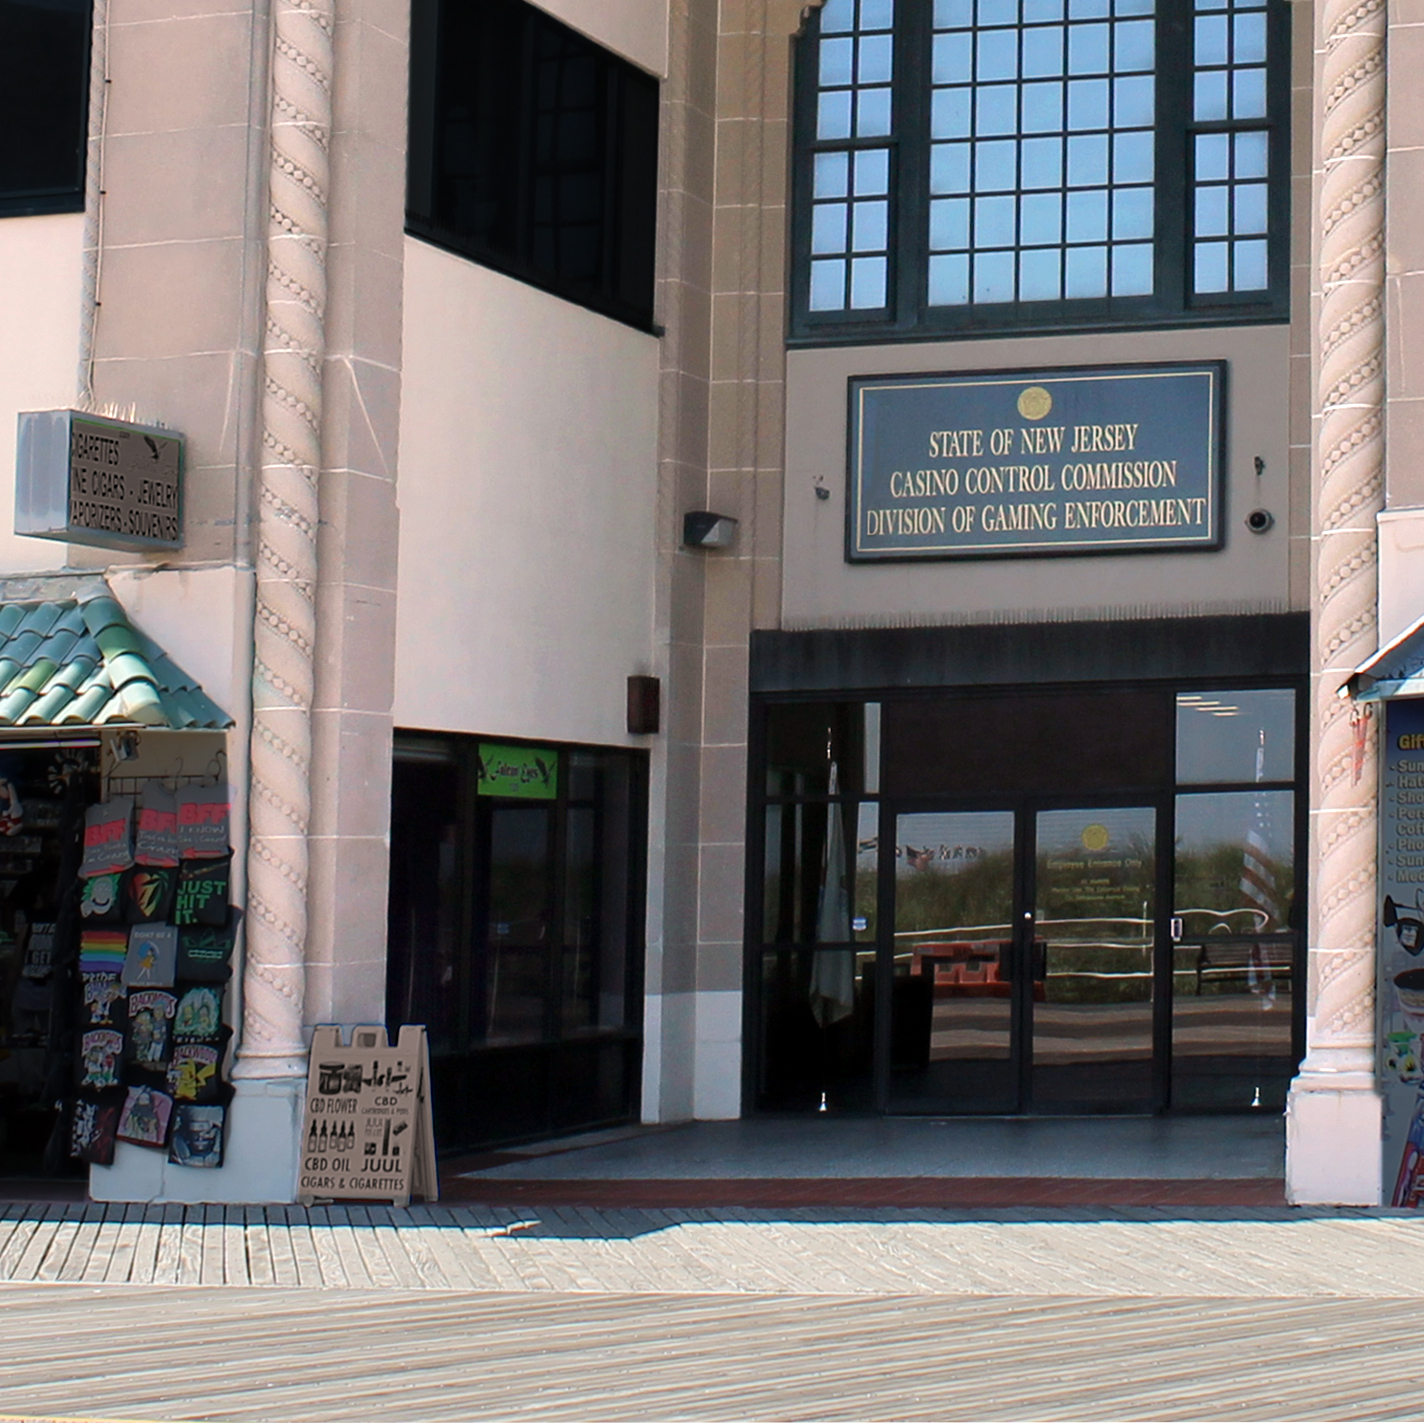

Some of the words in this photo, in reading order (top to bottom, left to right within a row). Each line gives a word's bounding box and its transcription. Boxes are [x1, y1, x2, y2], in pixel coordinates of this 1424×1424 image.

[929, 429, 983, 458] STATE
[990, 428, 1013, 456] OF
[1020, 426, 1065, 455] NEW
[1071, 423, 1138, 454] JERSEY
[92, 470, 124, 500] CIGARS
[890, 468, 958, 498] CASINO
[965, 464, 1055, 495] CONTROL
[1061, 460, 1177, 492] COMMISSION
[866, 507, 945, 536] DIVISION
[953, 504, 975, 532] OF
[982, 502, 1056, 532] GAMING
[1064, 497, 1206, 529] ENFORCEMENT
[180, 802, 231, 825] BFF
[84, 818, 125, 847] BFF
[177, 879, 226, 895] JUST
[176, 894, 210, 909] HIT
[175, 909, 198, 925] IT.
[310, 1097, 326, 1114] CBD
[326, 1097, 358, 1114] FLOWER
[375, 1096, 398, 1106] CBD
[305, 1157, 327, 1171] CBD
[332, 1158, 351, 1172] OIL
[361, 1158, 403, 1173] JUUL
[301, 1176, 335, 1189] CIGARS
[339, 1177, 346, 1189] &
[349, 1178, 405, 1191] CIGARETTES
